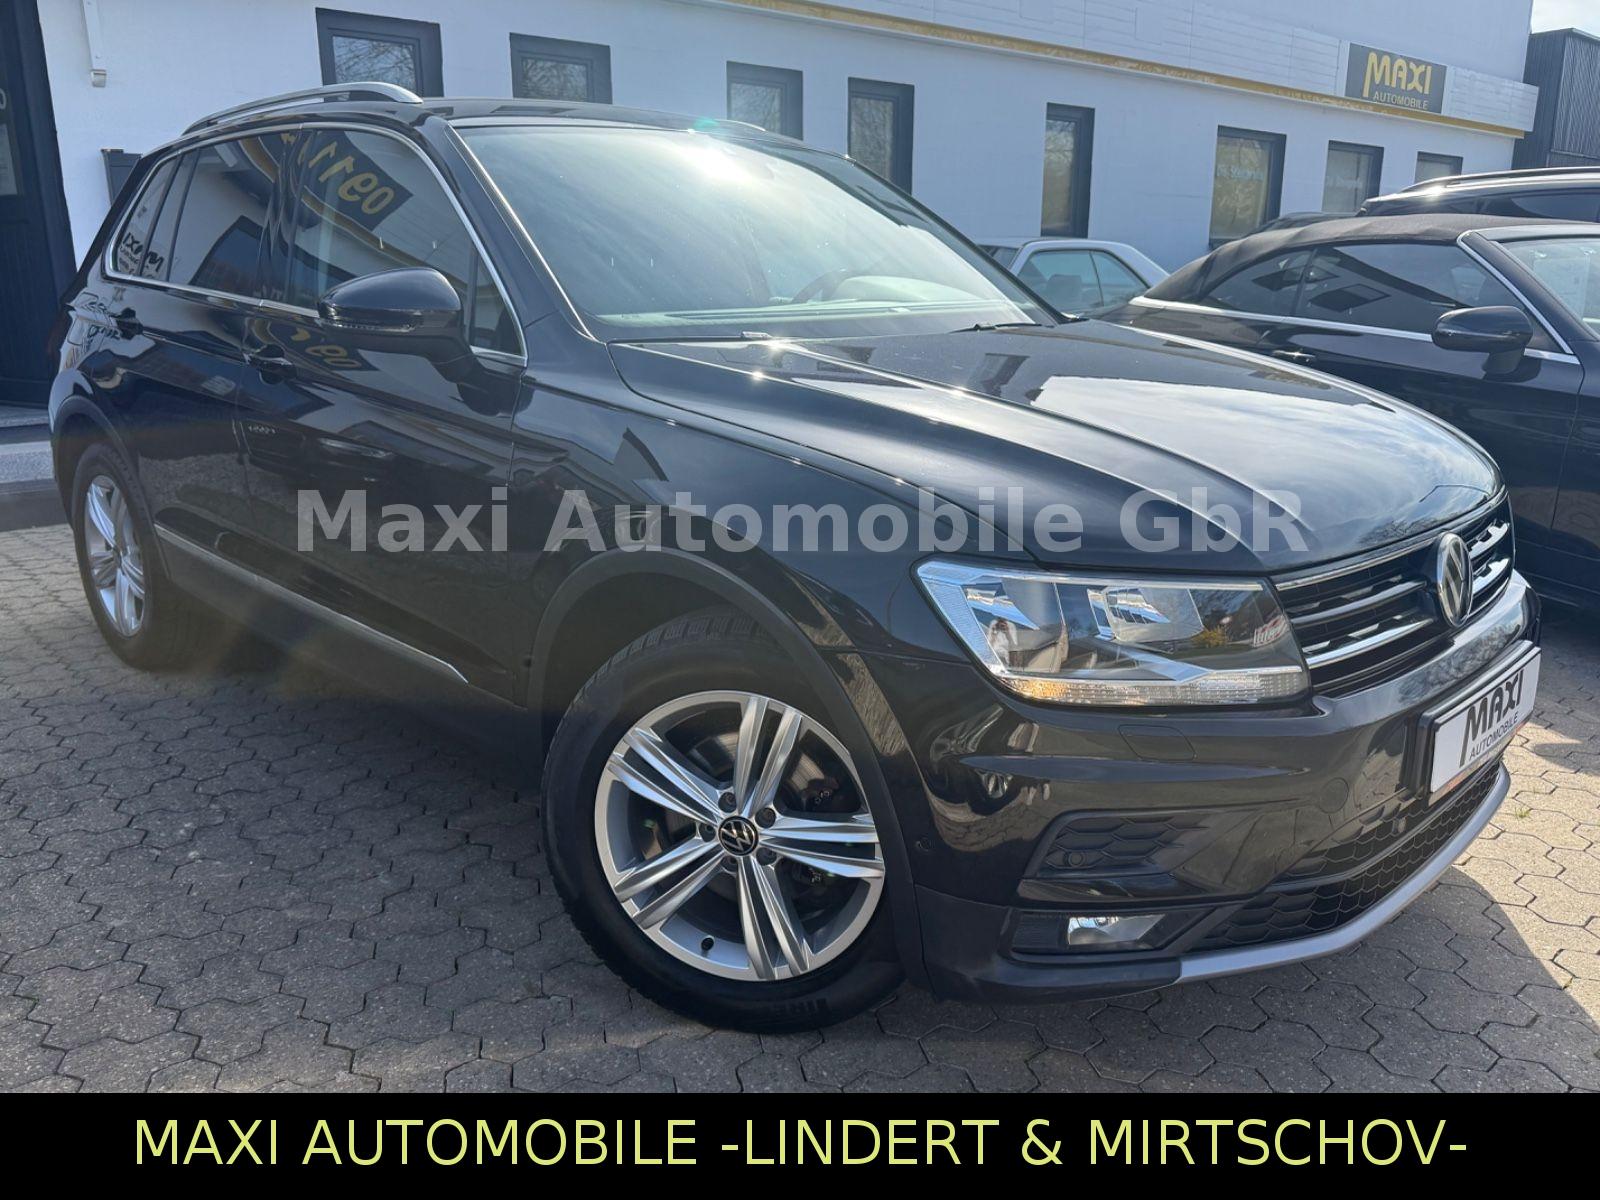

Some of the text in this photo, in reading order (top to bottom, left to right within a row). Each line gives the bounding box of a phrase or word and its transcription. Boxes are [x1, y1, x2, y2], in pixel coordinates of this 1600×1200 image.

[1362, 51, 1433, 98] MAXI
[1373, 90, 1429, 111] AUTOMOBILE
[1459, 669, 1525, 768] MAXI
[1469, 711, 1519, 761] AUTOMOBILE
